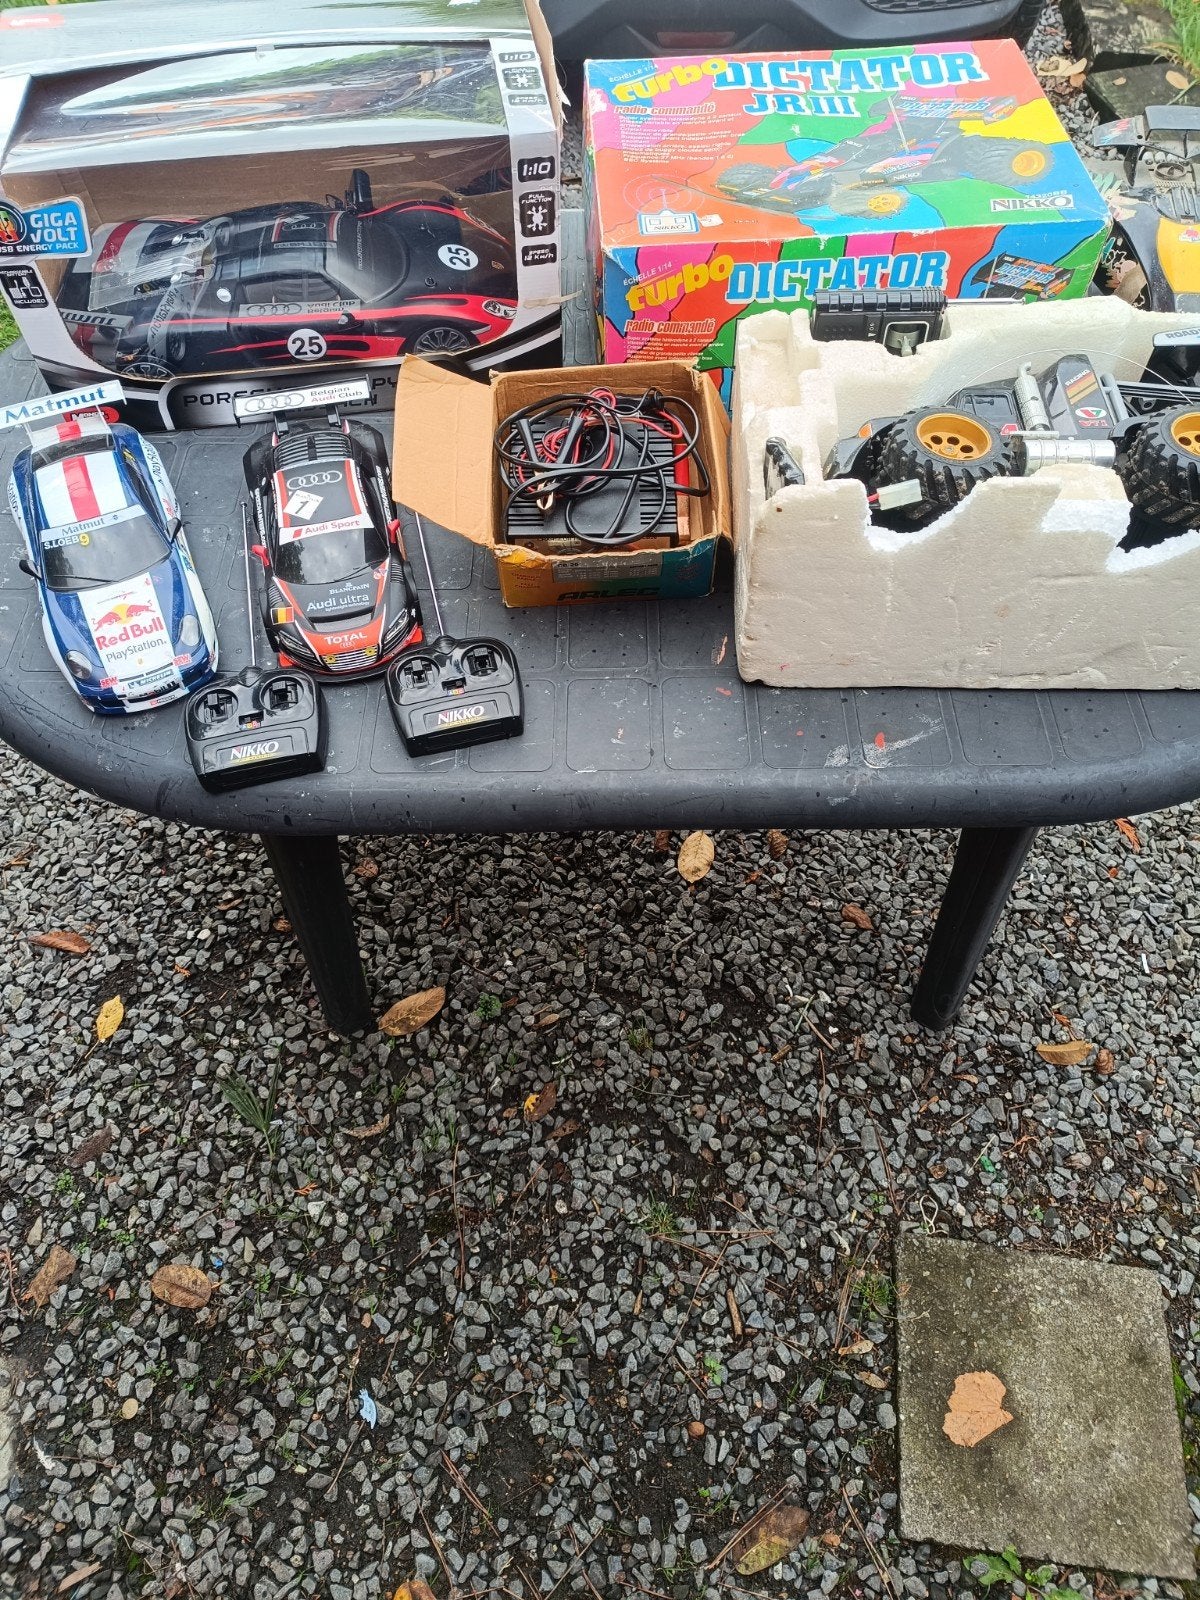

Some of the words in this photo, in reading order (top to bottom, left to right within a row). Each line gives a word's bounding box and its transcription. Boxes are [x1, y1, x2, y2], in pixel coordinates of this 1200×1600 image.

[611, 58, 728, 103] turbo
[712, 52, 989, 93] DICTATOR
[613, 104, 649, 116] radio
[649, 101, 716, 117] commandé
[522, 162, 551, 176] 1:10
[992, 196, 1072, 211] NIKKO
[30, 212, 78, 229] GIGA
[30, 227, 78, 243] VOLT
[16, 243, 53, 253] ENERGY
[56, 242, 79, 250] PACK
[447, 246, 472, 268] 25
[657, 261, 673, 273] 1/14
[625, 255, 734, 312] turbo
[725, 251, 951, 304] DICTATOR
[623, 319, 655, 333] radio
[656, 317, 717, 336] commandé
[292, 336, 323, 356] 25
[310, 386, 350, 396] Belgian
[311, 395, 336, 403] Audi
[338, 390, 363, 399] Club
[5, 387, 107, 424] Matmut
[61, 517, 105, 537] Matmut
[305, 522, 328, 536] Audi
[330, 519, 361, 533] Sport
[44, 535, 79, 550] S.LOEB
[79, 532, 89, 546] 9
[307, 598, 337, 612] Audi
[339, 594, 370, 605] ultra
[324, 632, 367, 645] TOTAL
[438, 705, 484, 725] NIKKO
[230, 741, 279, 760] NIKKO
